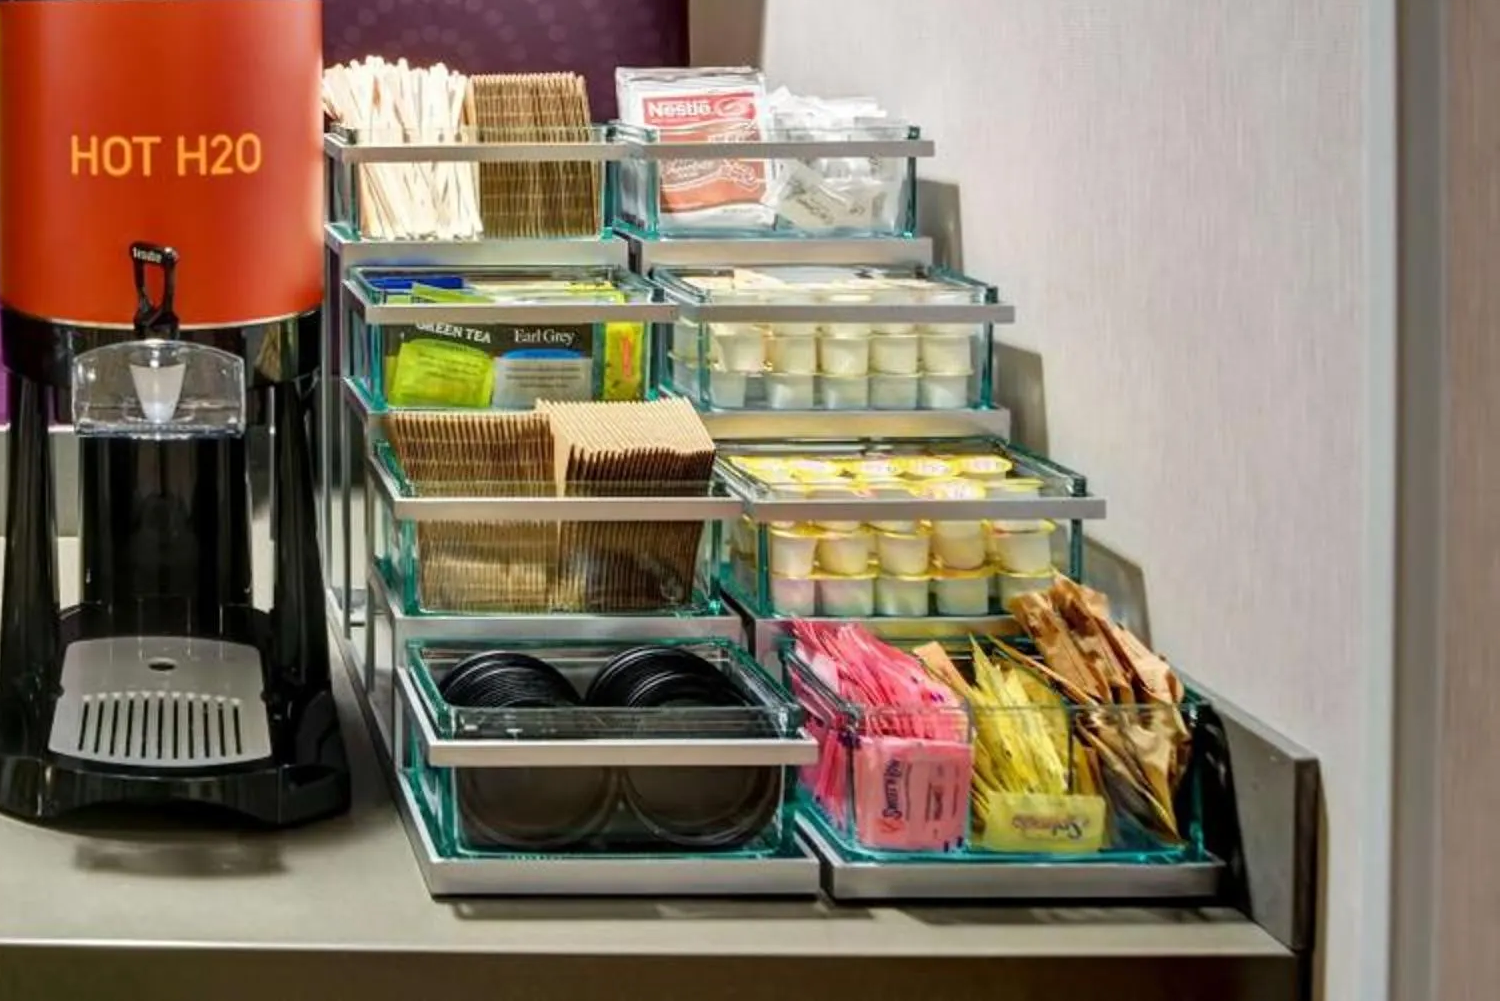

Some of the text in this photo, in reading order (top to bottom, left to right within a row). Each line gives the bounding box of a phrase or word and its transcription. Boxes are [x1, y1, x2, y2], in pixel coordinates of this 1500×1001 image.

[71, 135, 162, 177] HOT
[465, 327, 491, 344] TEA
[514, 328, 575, 346] Earl Grey
